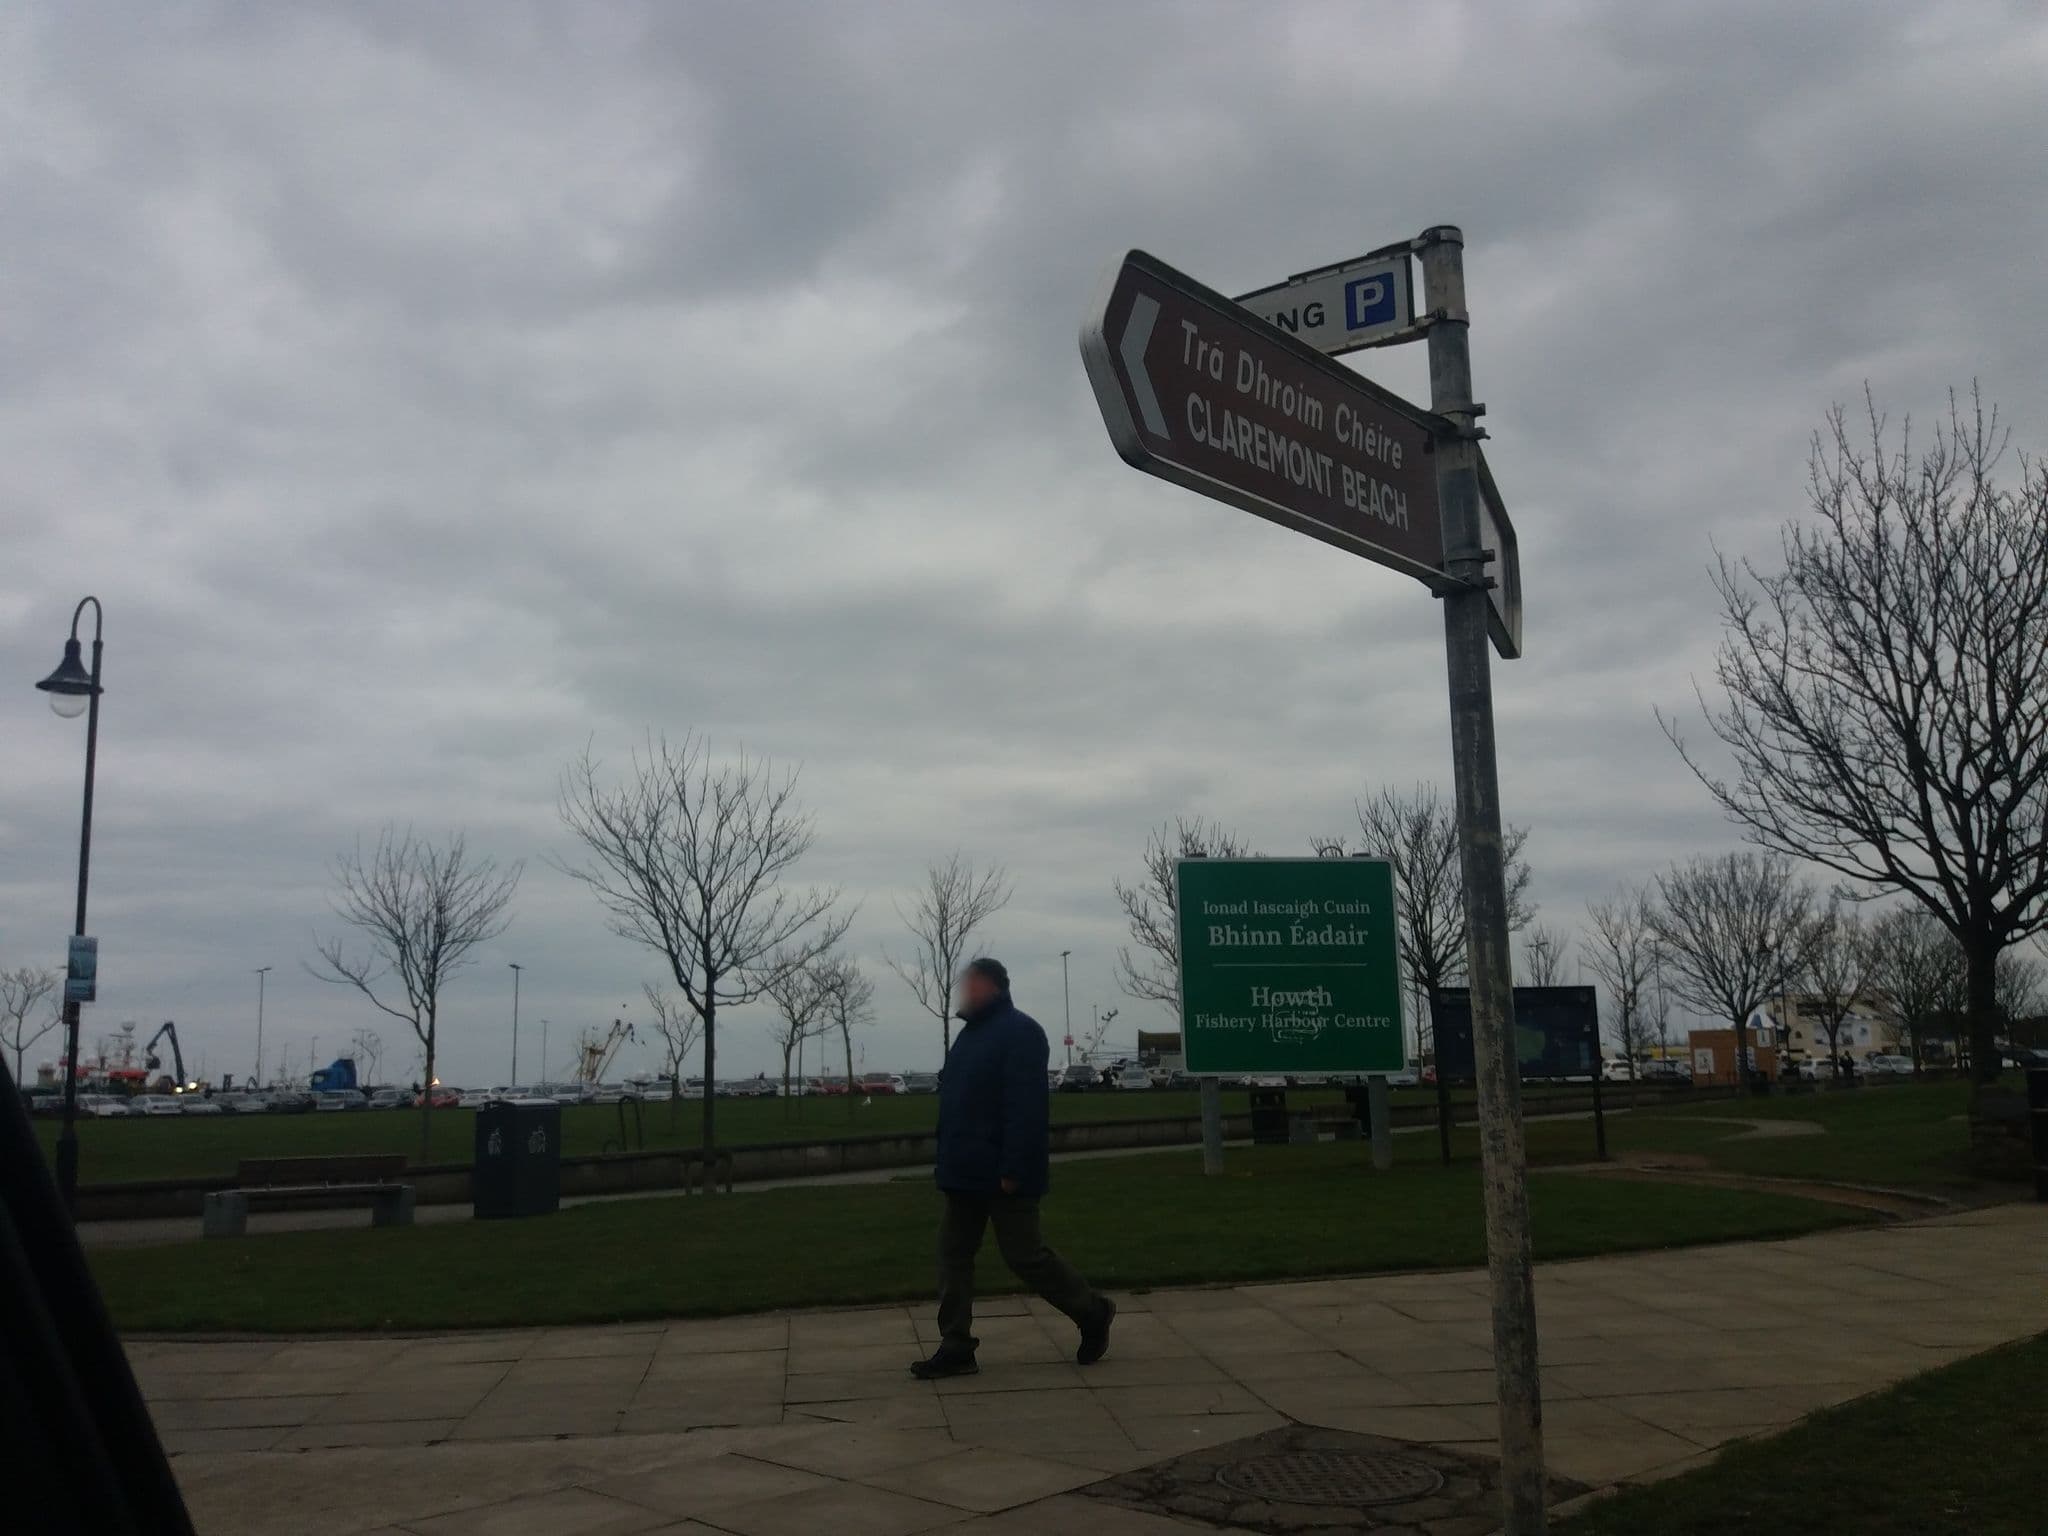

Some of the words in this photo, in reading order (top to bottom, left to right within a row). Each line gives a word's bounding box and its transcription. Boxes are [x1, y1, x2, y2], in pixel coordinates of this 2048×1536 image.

[1355, 279, 1385, 325] P
[1265, 302, 1325, 333] NG
[1181, 319, 1225, 382] Trá
[1236, 349, 1324, 431] Dhroim
[1335, 402, 1403, 470] Chéire
[1186, 392, 1334, 498] CLAREMONT
[1341, 463, 1409, 532] BEACH
[1203, 900, 1249, 915] Ionad
[1253, 899, 1319, 919] Iascaigh
[1324, 899, 1371, 915] Cuain
[1208, 924, 1283, 947] Bhinn
[1289, 919, 1369, 946] Éadair
[1249, 985, 1334, 1008] Howth
[1195, 1014, 1257, 1033] Fishery
[1261, 1013, 1330, 1029] Harbour
[1334, 1013, 1392, 1029] Centre
